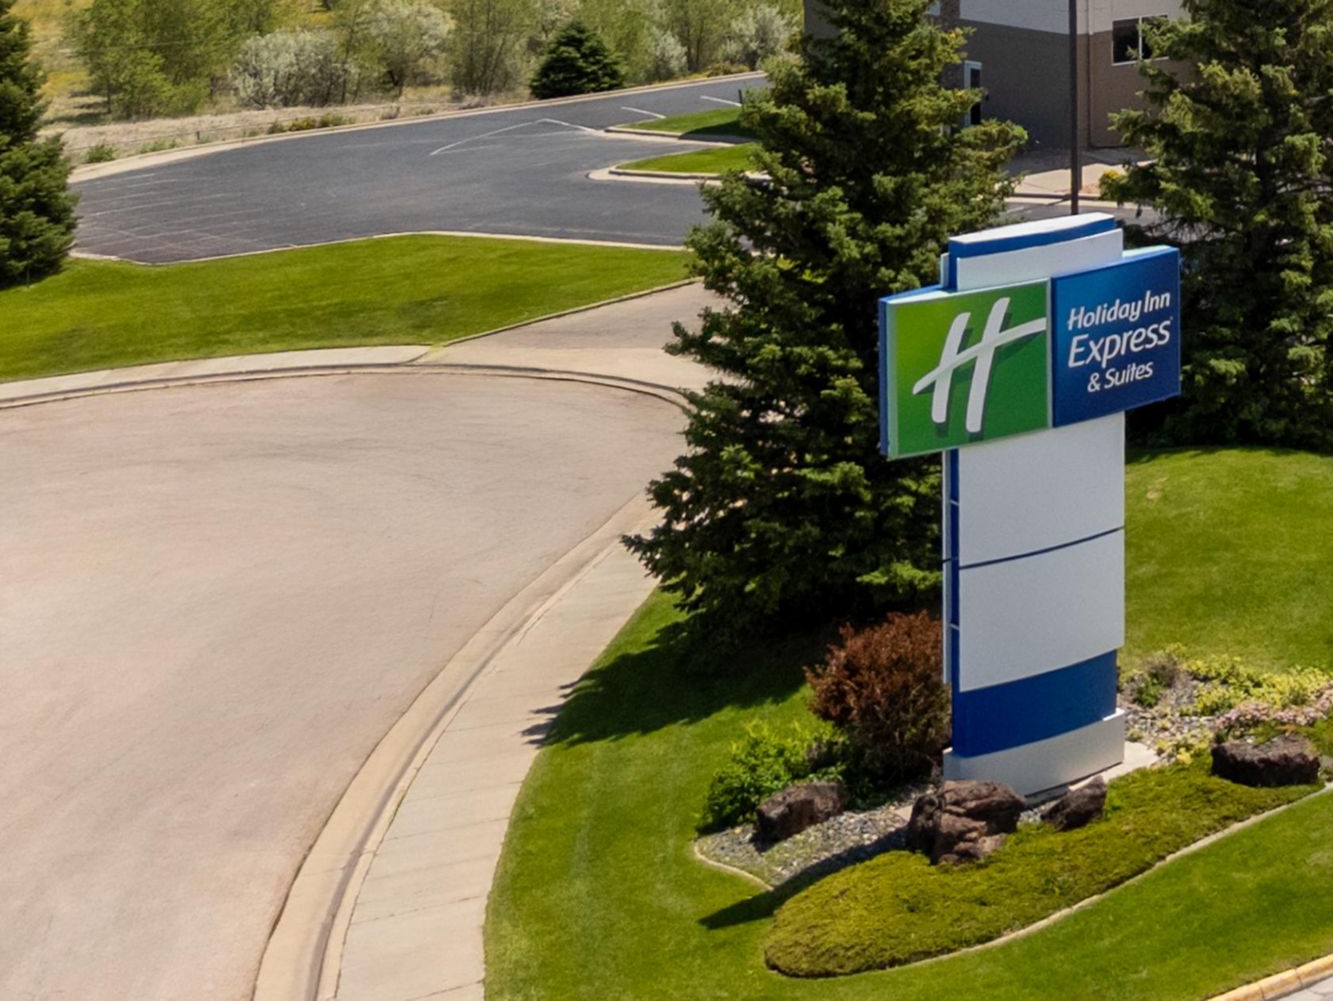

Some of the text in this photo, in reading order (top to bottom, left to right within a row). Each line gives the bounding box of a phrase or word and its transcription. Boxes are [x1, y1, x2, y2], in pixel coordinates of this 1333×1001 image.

[1067, 289, 1171, 331] Holiday Inn
[1068, 319, 1171, 369] Express
[1087, 361, 1154, 392] & Suites
